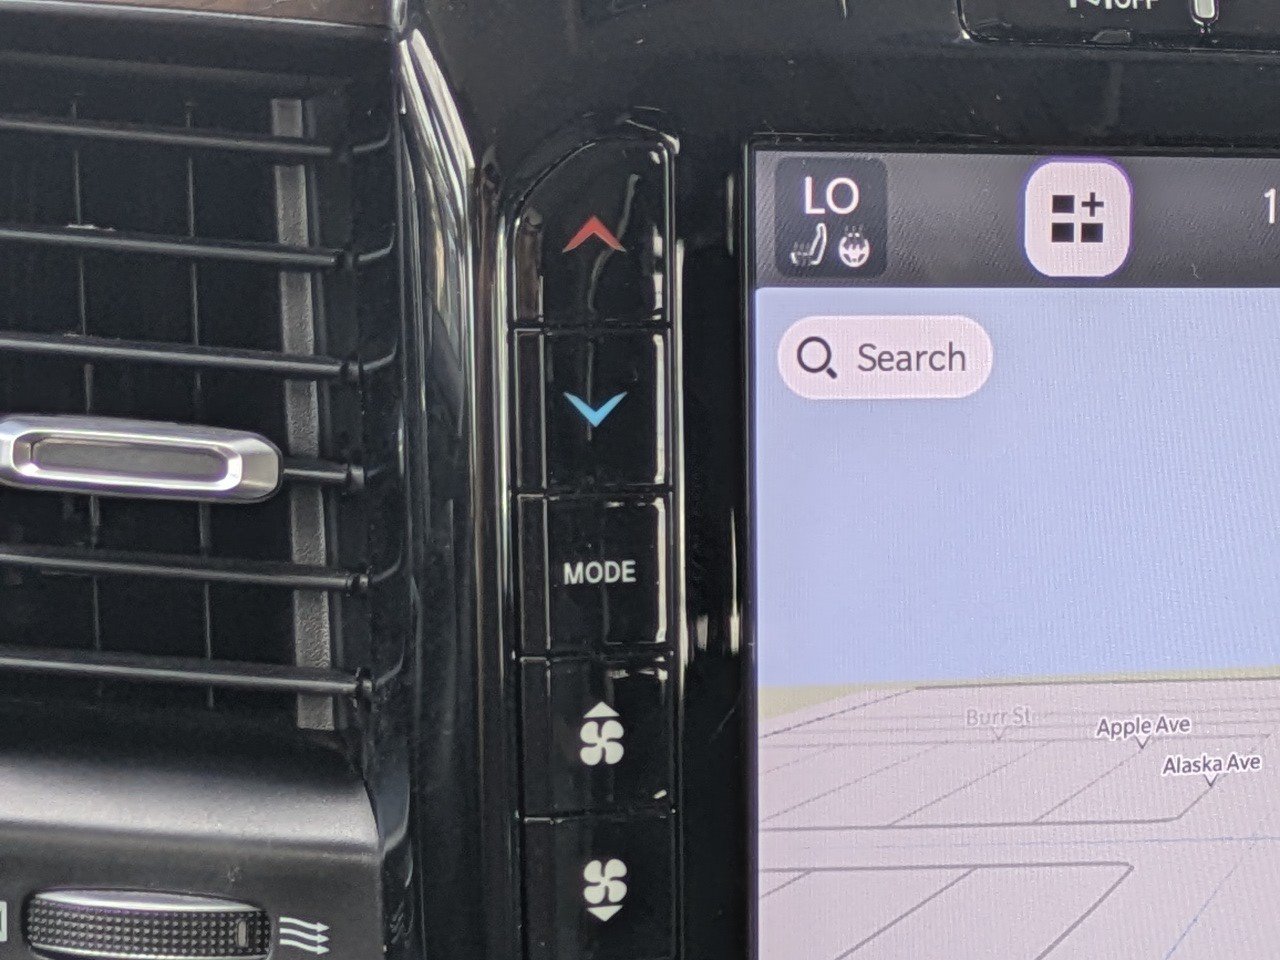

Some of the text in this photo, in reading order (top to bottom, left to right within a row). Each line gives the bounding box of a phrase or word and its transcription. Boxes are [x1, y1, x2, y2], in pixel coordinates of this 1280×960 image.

[803, 176, 860, 215] LO
[856, 341, 967, 373] Search
[563, 560, 637, 585] MODE
[966, 709, 1008, 727] Burr
[1096, 717, 1191, 740] Apple Ave
[1162, 754, 1262, 775] Alaska Ave
